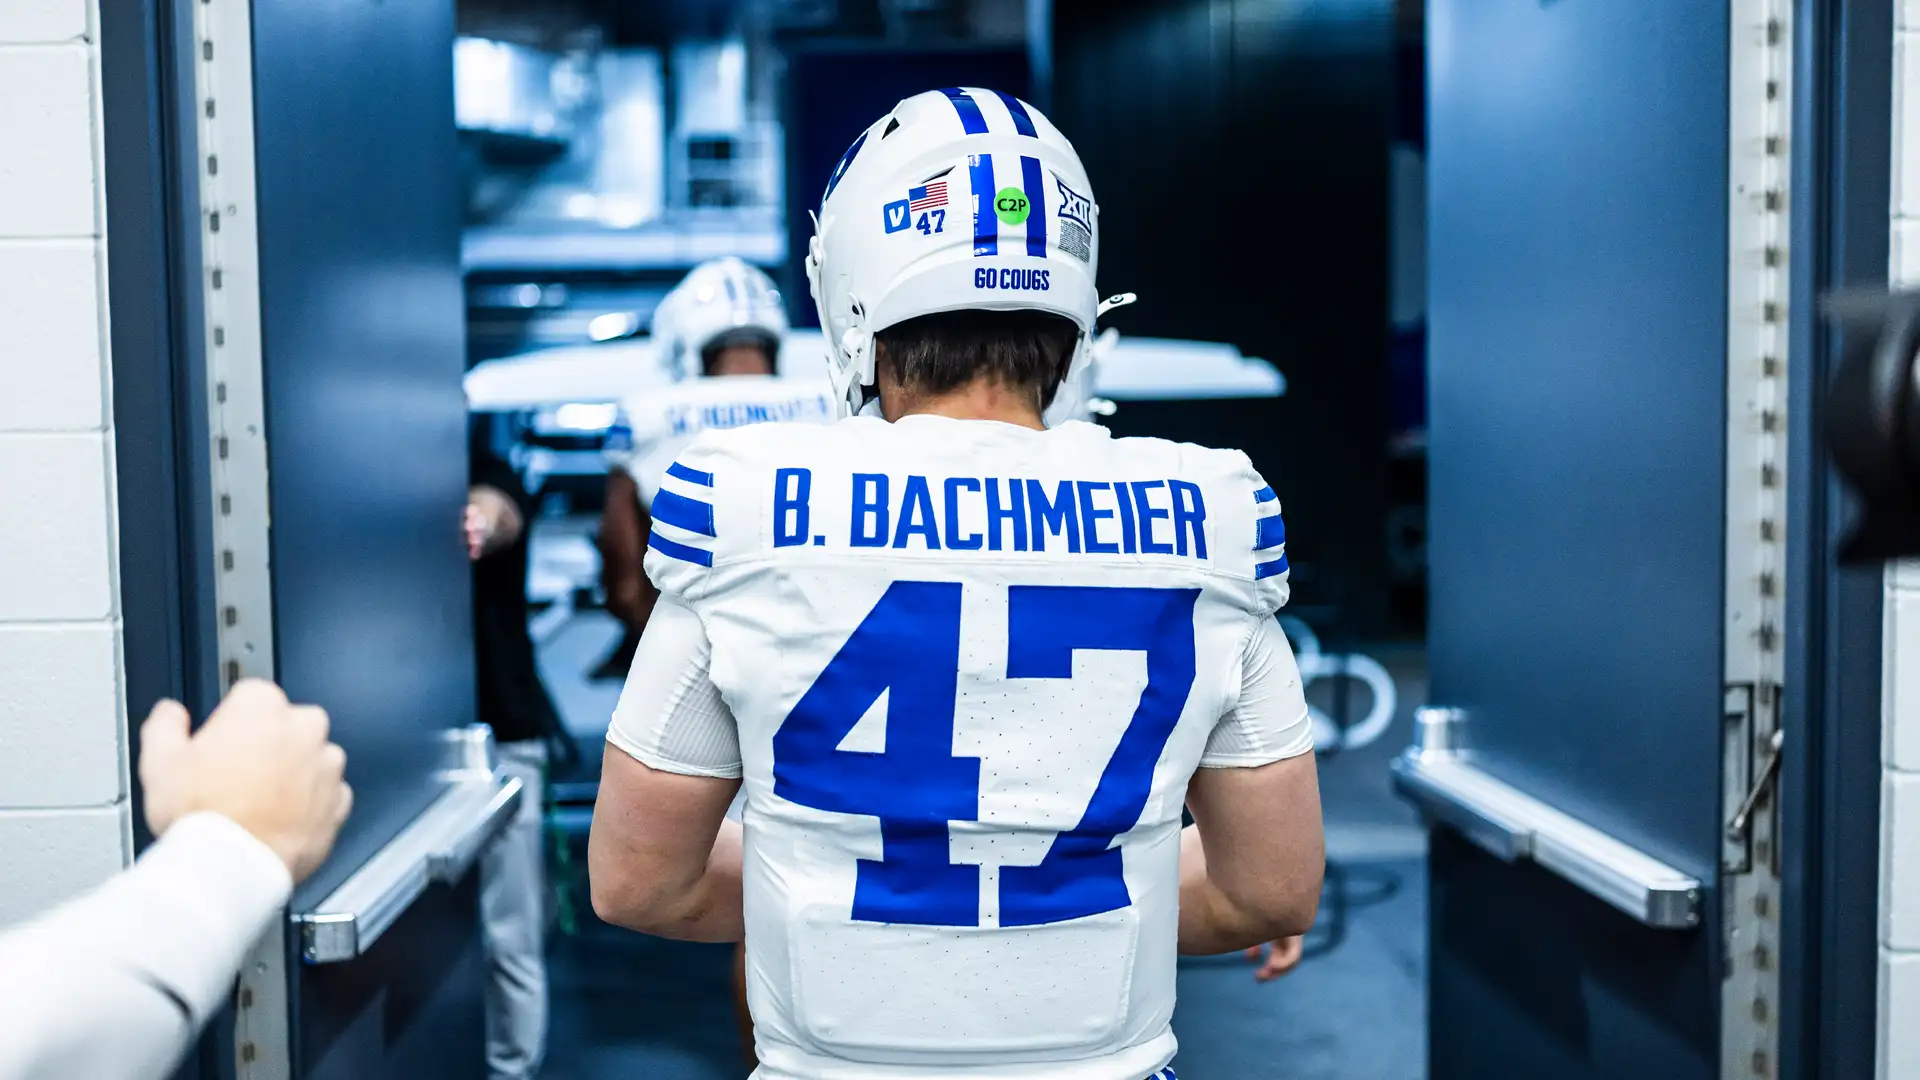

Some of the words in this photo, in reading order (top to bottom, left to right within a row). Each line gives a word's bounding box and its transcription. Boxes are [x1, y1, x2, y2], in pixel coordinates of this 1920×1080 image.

[997, 198, 1027, 212] C2P
[916, 209, 946, 235] 47
[974, 267, 997, 289] GO
[1000, 268, 1050, 291] COUGS
[774, 467, 826, 548] B.
[850, 473, 1208, 560] BACHMEIER
[773, 580, 1203, 927] 47
